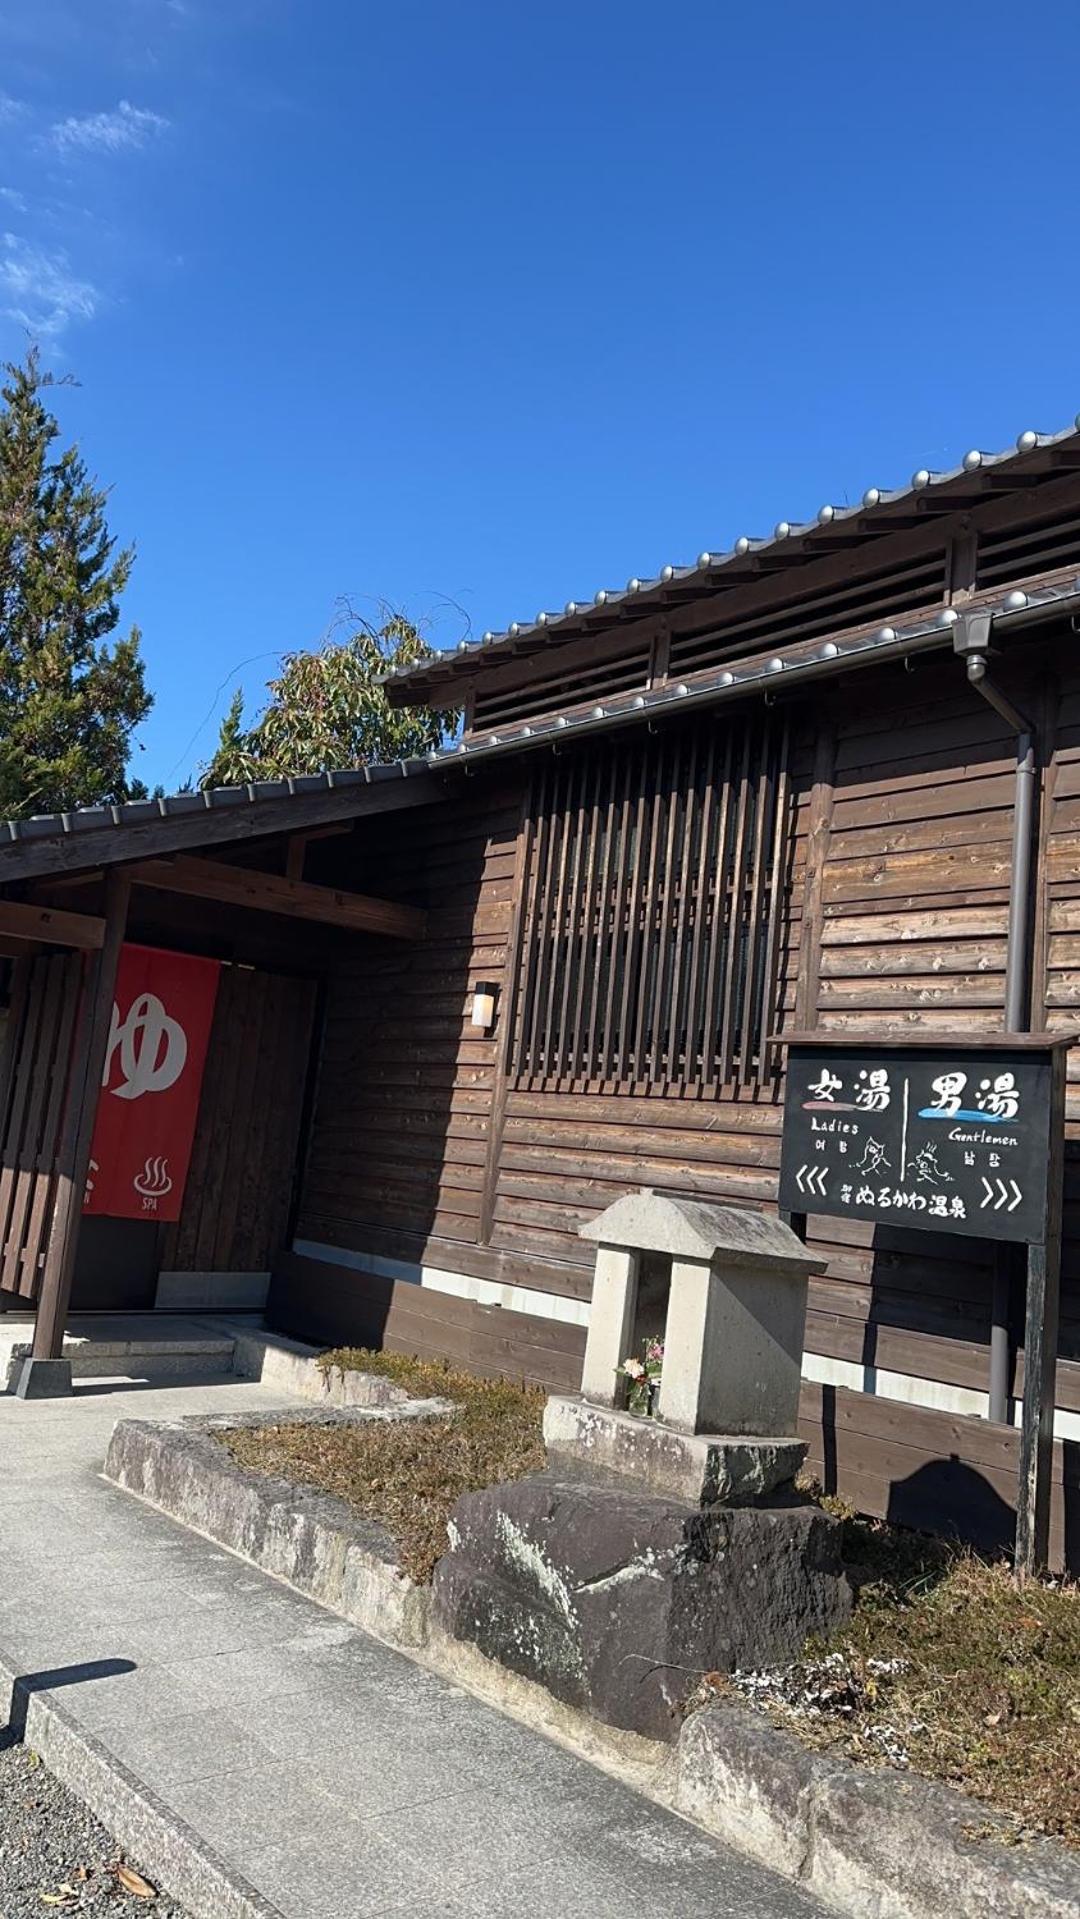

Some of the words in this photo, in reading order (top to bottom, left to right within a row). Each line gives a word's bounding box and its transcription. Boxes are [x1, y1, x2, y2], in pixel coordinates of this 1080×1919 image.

[102, 992, 188, 1100] ゆ
[808, 1068, 892, 1111] 女湯
[931, 1071, 1020, 1119] 男湯
[811, 1117, 860, 1135] Ladies
[948, 1127, 1018, 1146] Gentlemen
[142, 1197, 159, 1210] SPA
[855, 1185, 967, 1219] ぬるかわ温泉
